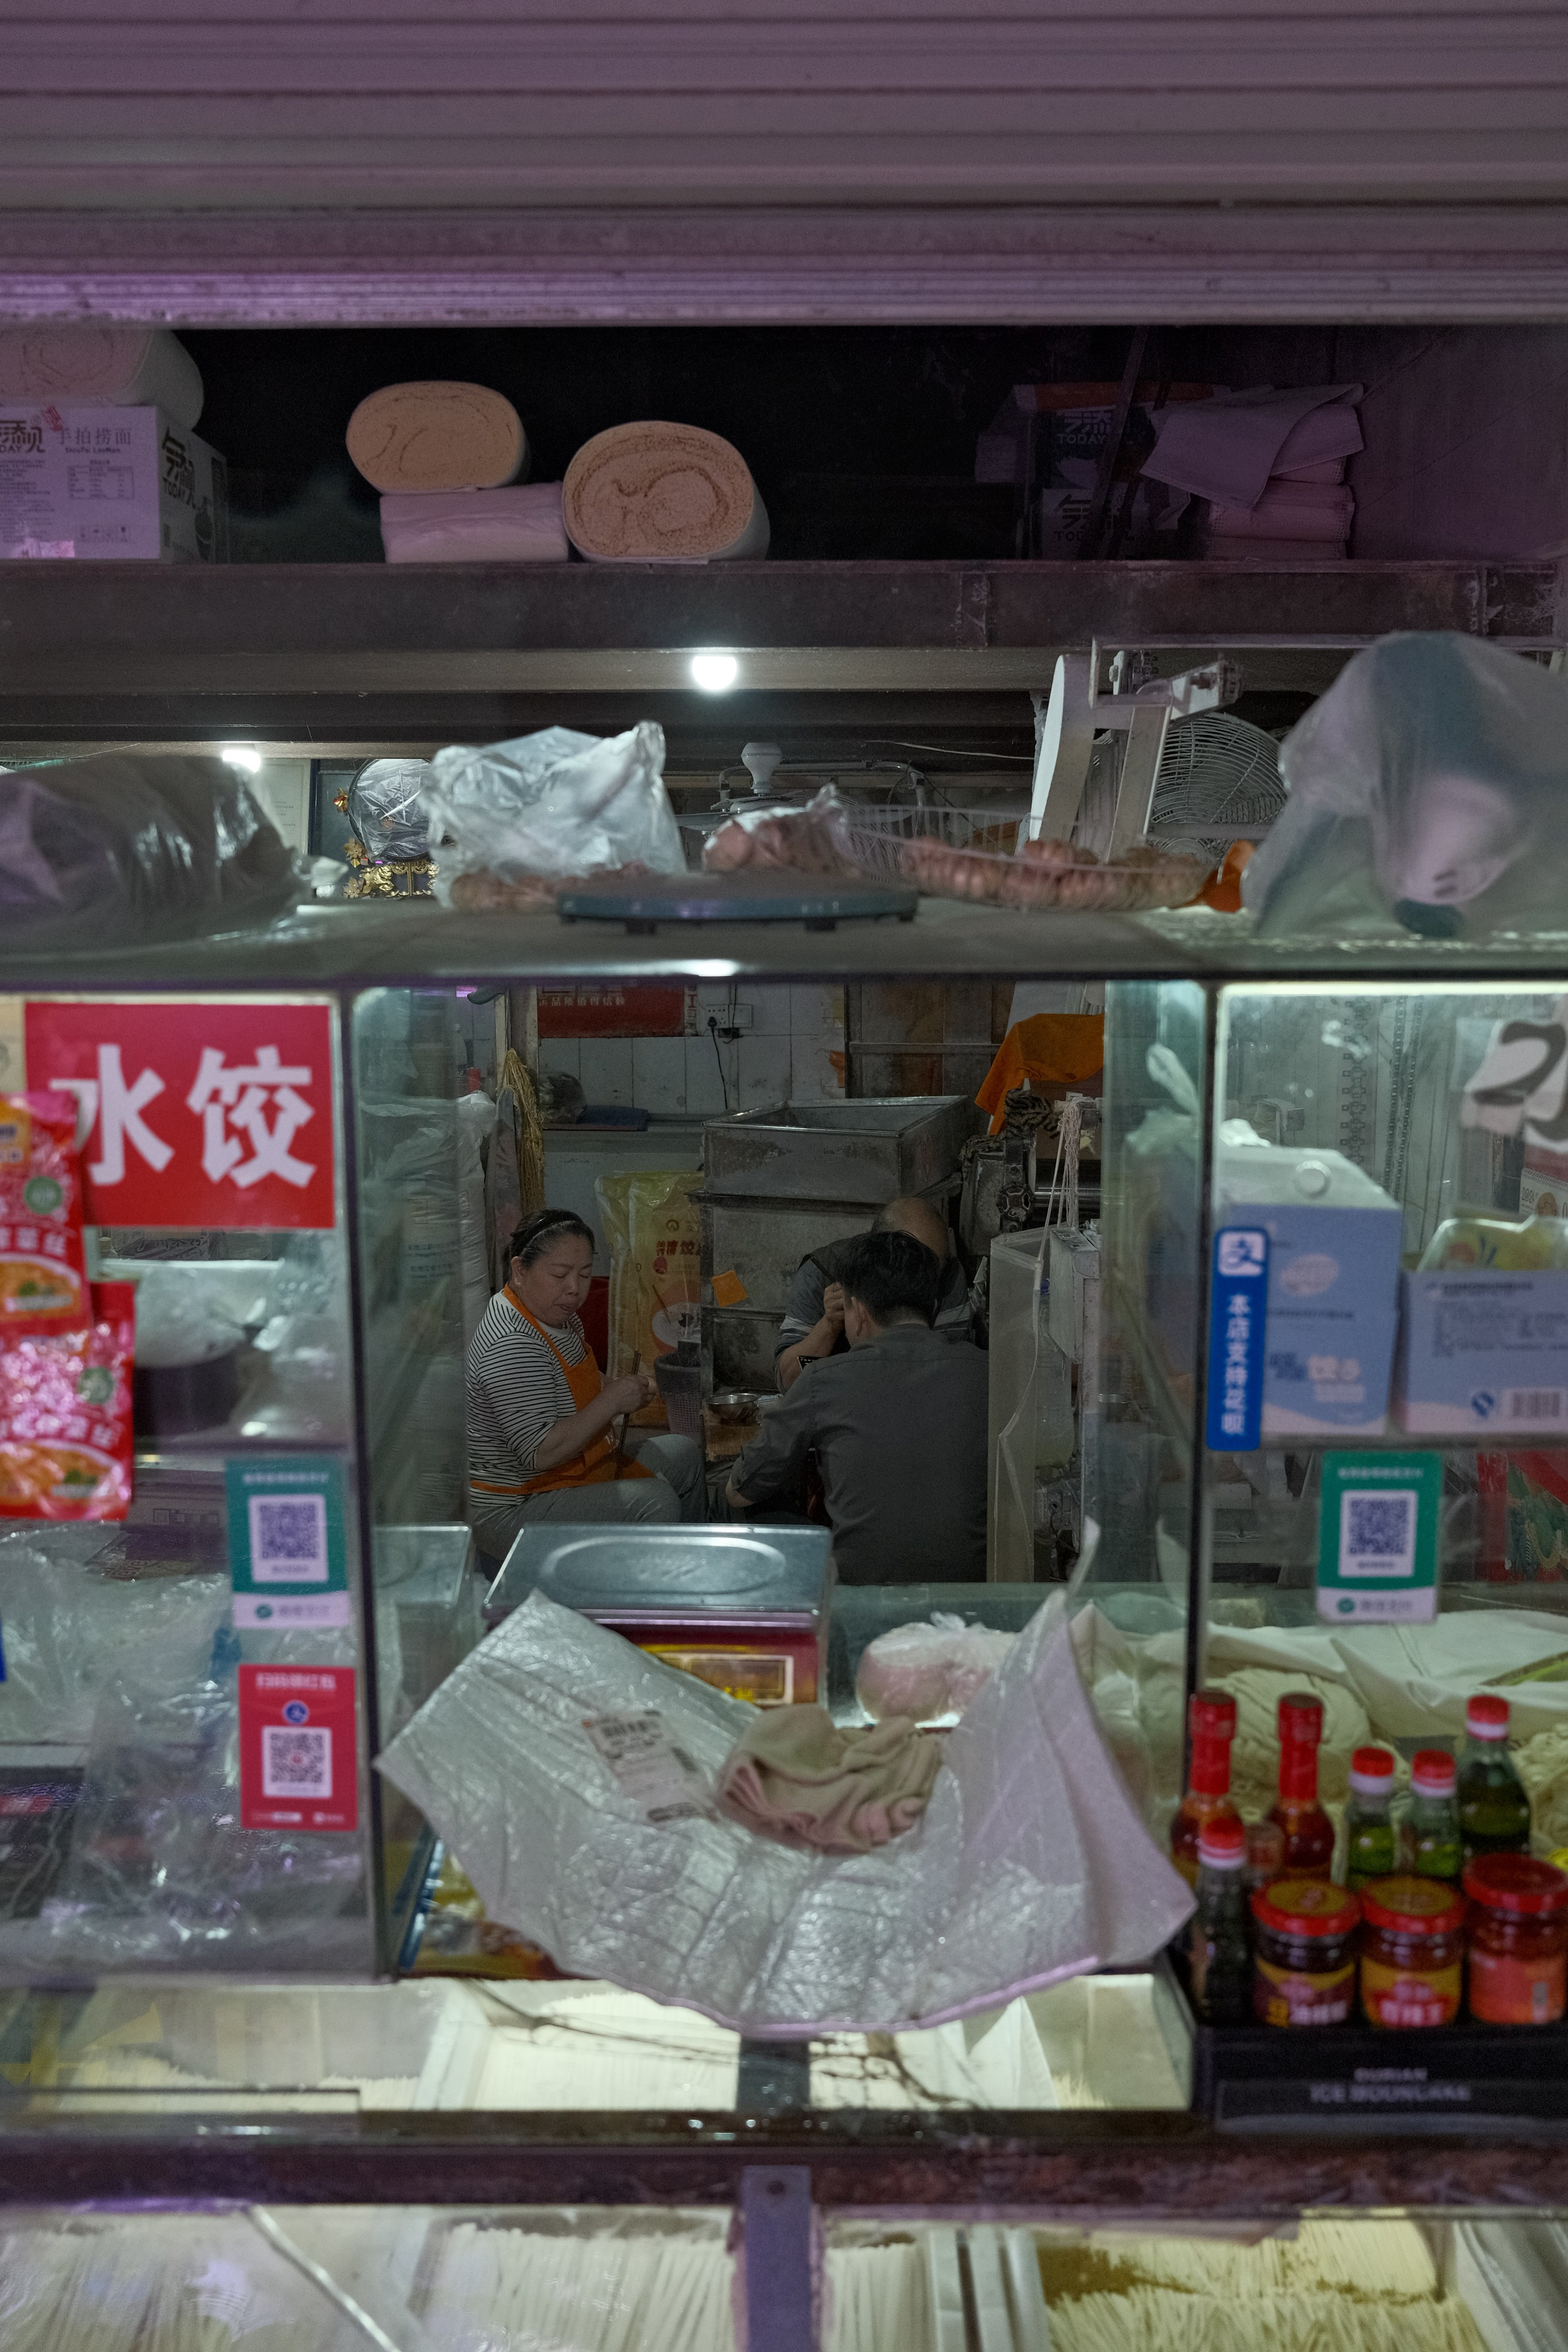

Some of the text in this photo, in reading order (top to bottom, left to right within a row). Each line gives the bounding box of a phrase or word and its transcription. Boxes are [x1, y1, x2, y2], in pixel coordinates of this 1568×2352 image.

[61, 428, 132, 445] 手拍捞面
[1056, 434, 1106, 445] TODAY
[48, 1043, 317, 1188] 水饺
